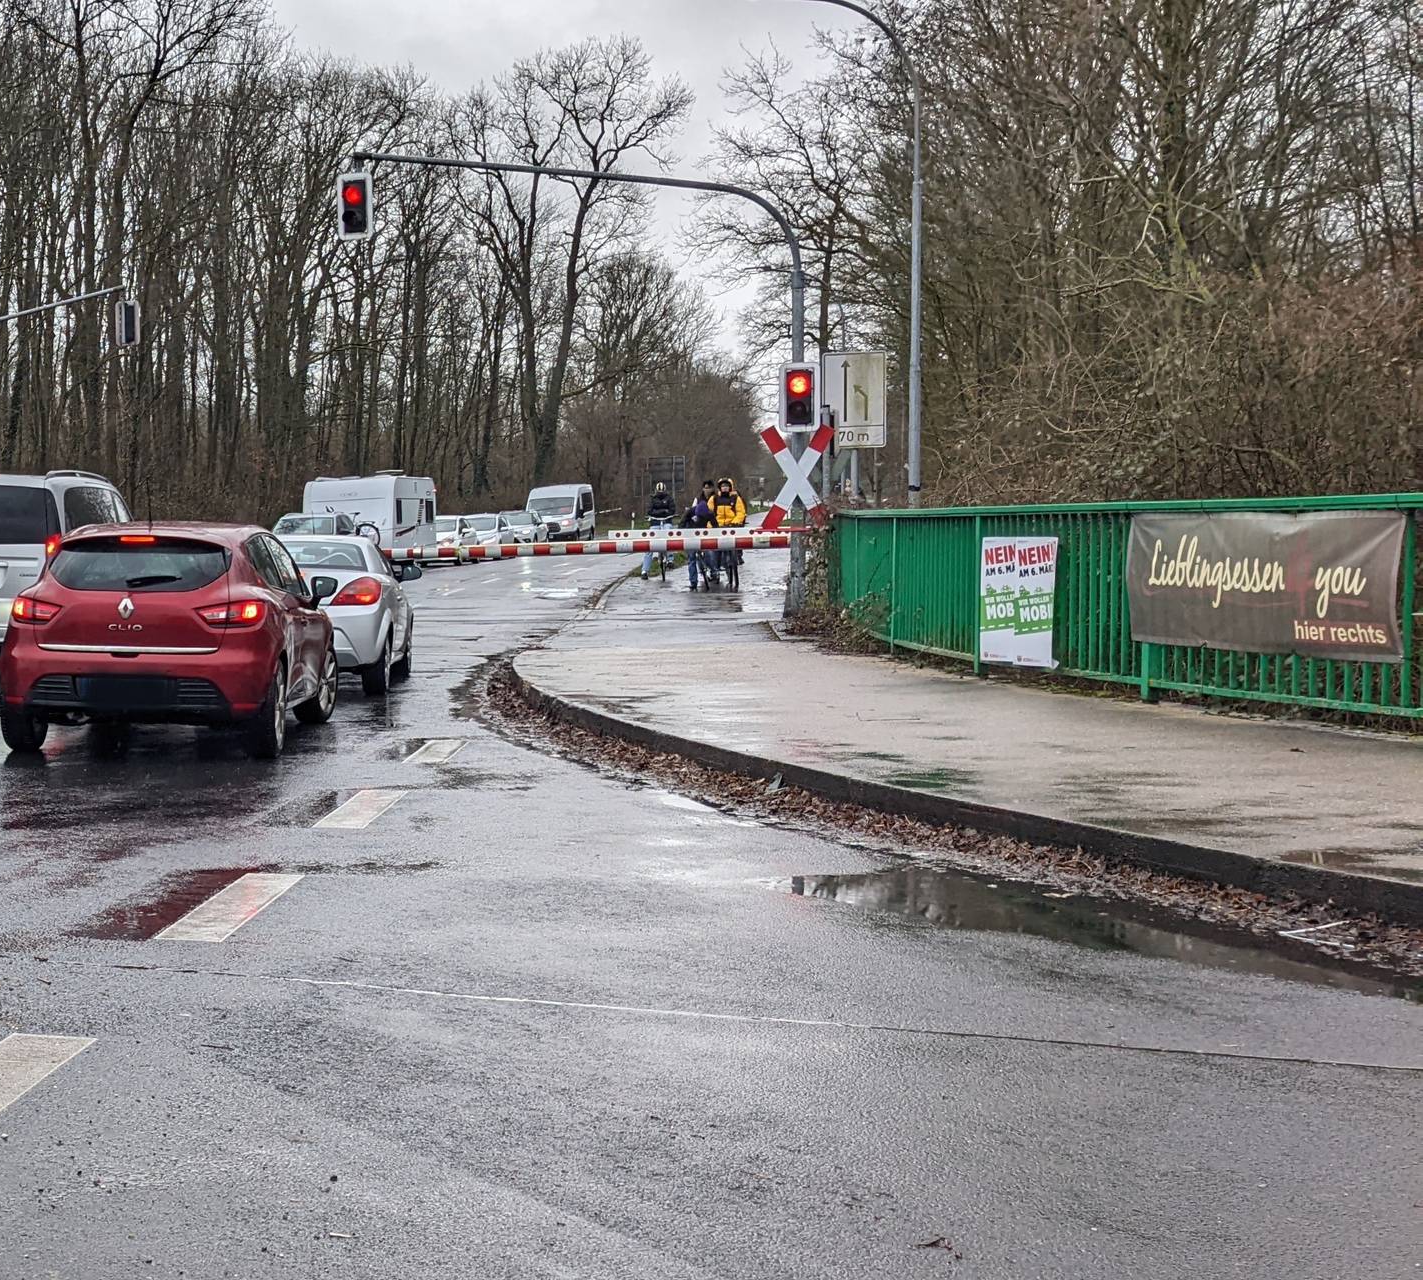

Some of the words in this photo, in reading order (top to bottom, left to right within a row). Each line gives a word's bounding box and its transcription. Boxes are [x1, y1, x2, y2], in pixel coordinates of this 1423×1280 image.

[839, 431, 854, 442] 70
[857, 434, 869, 442] m
[984, 544, 1016, 566] NEIN
[985, 567, 996, 577] AM
[997, 566, 1005, 575] 6.
[1019, 568, 1029, 578] AM
[1031, 567, 1038, 576] 6.
[1149, 534, 1285, 608] Lieblingsessen
[1315, 565, 1367, 618] you
[985, 602, 1015, 620] MOB
[108, 623, 143, 631] CLIO
[1294, 620, 1325, 641] hier
[1329, 624, 1387, 644] rechts
